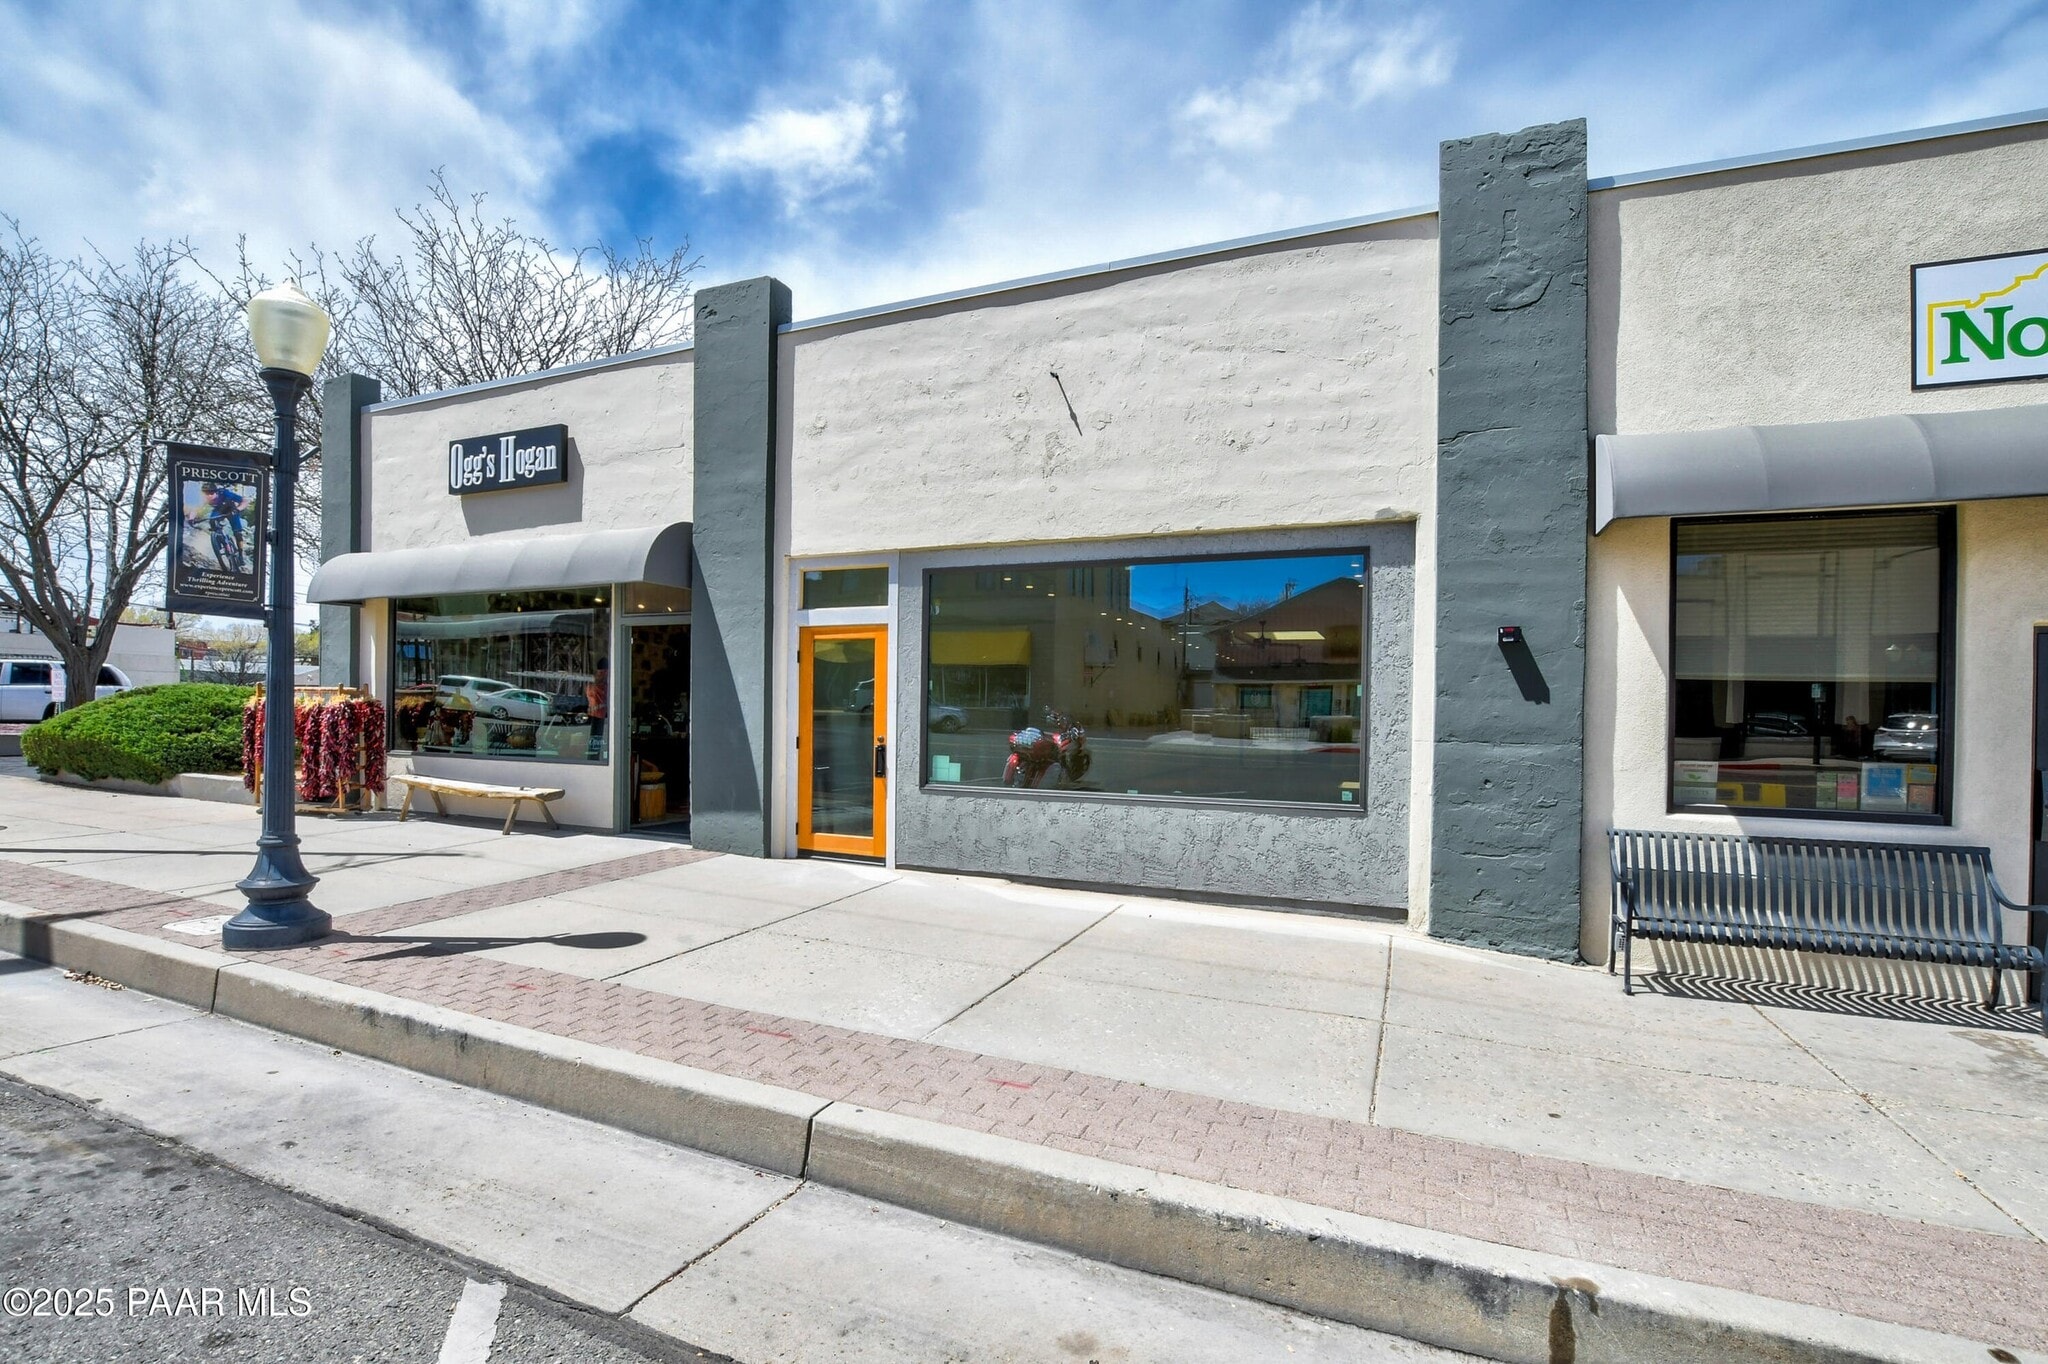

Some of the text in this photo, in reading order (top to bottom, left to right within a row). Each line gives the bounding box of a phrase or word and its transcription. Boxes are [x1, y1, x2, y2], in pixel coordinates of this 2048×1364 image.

[1941, 304, 2048, 365] No
[450, 435, 557, 489] Ogg's Hogan
[181, 466, 259, 484] PRESCOTT
[188, 576, 216, 586] Thrilling
[201, 571, 235, 580] Experience
